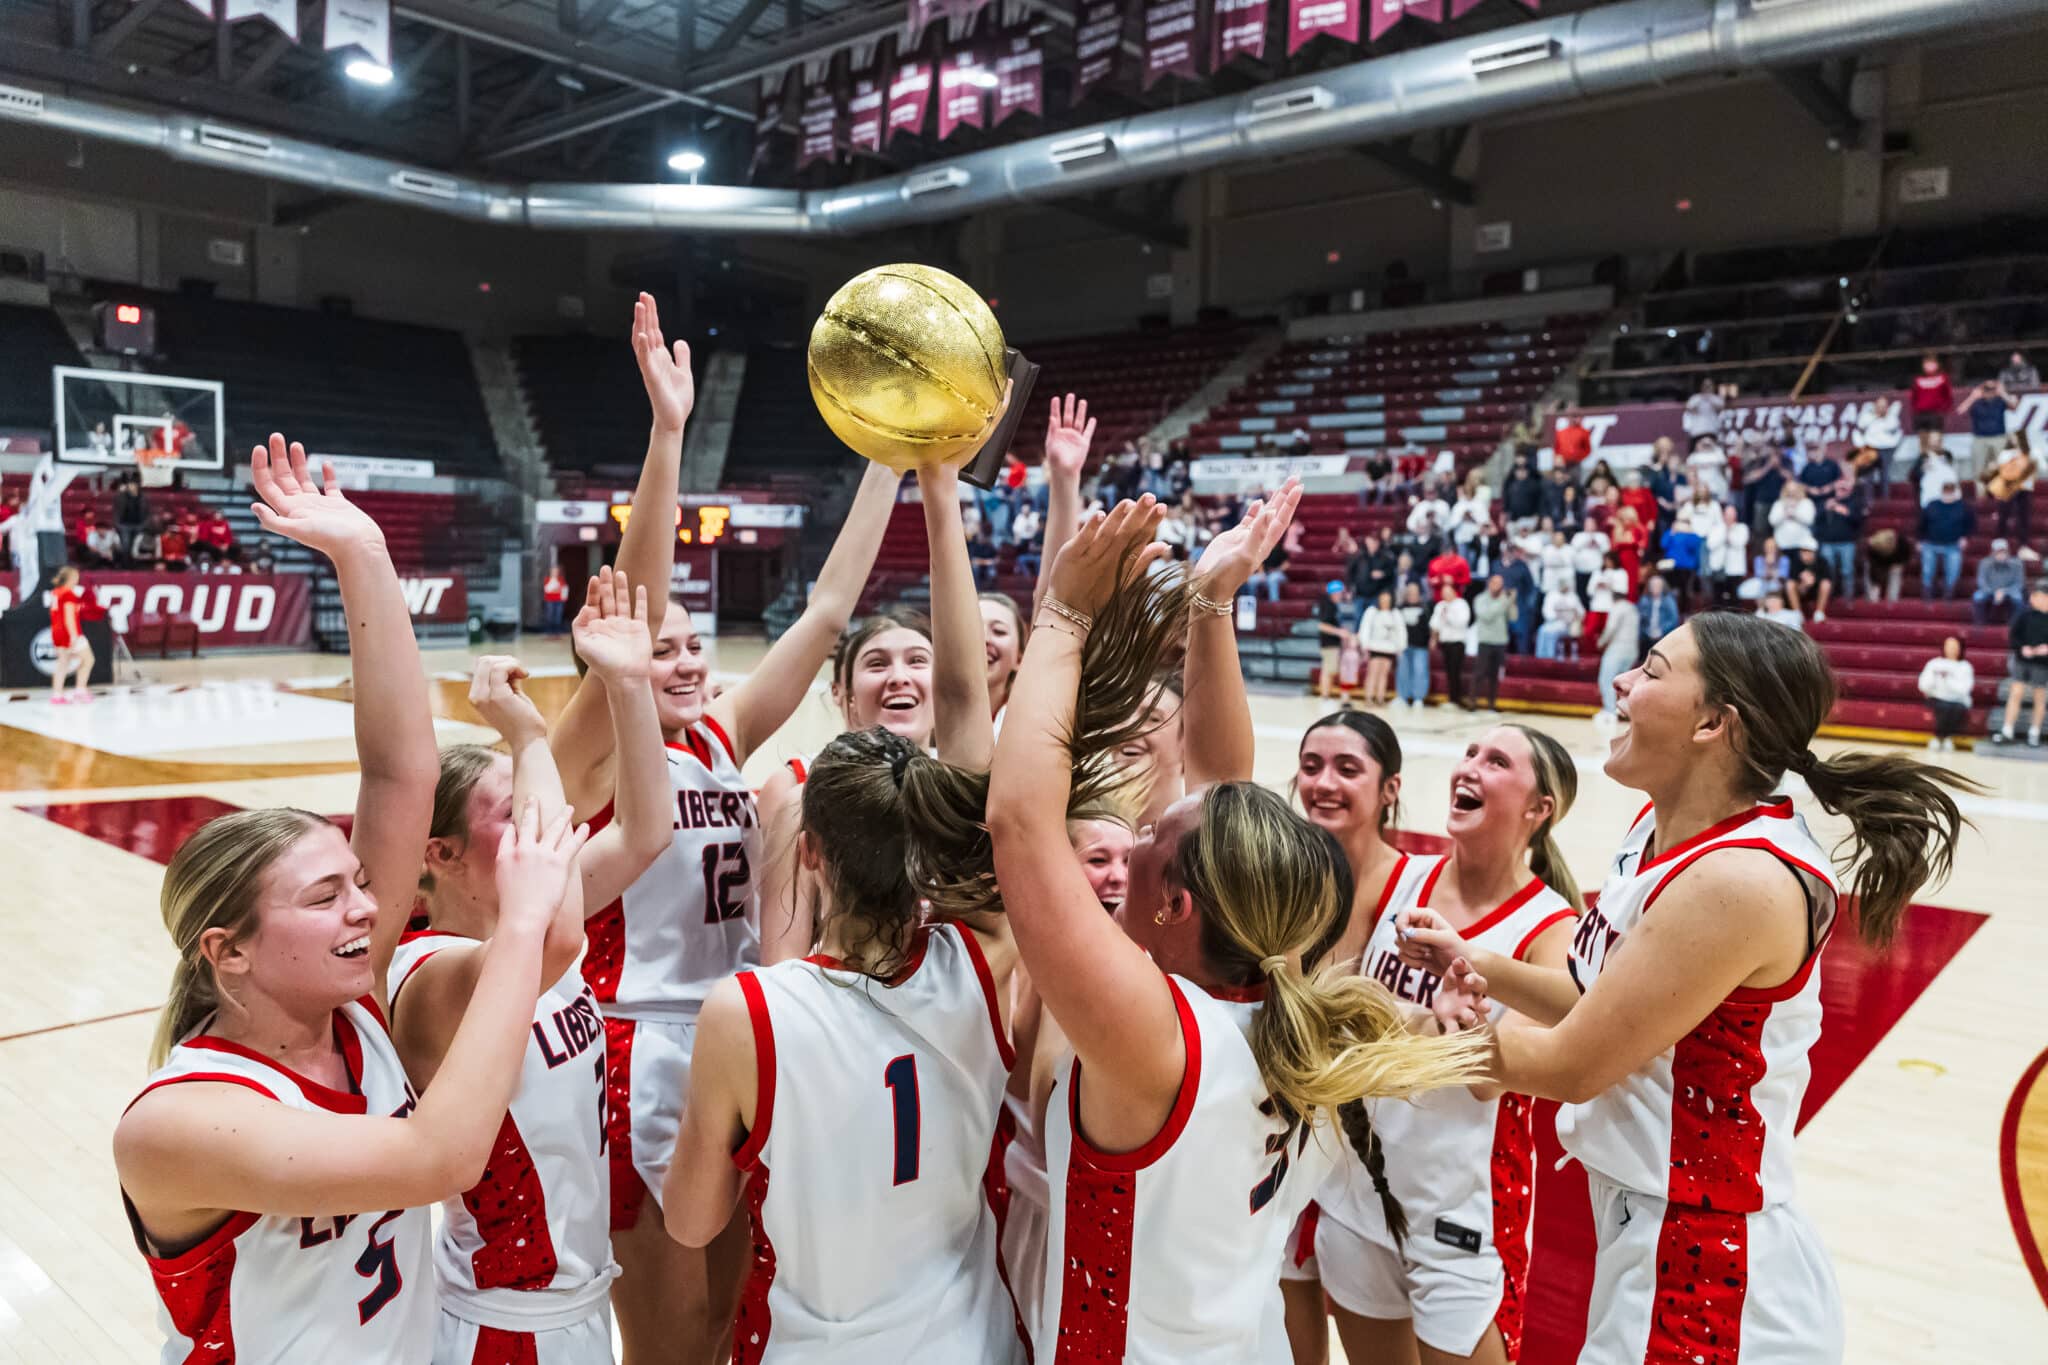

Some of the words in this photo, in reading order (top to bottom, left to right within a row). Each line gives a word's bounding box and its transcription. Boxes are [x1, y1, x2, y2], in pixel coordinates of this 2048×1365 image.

[43, 584, 276, 633] ROUD
[673, 789, 761, 830] IBERT
[702, 842, 751, 924] 12
[884, 1053, 921, 1187] 1
